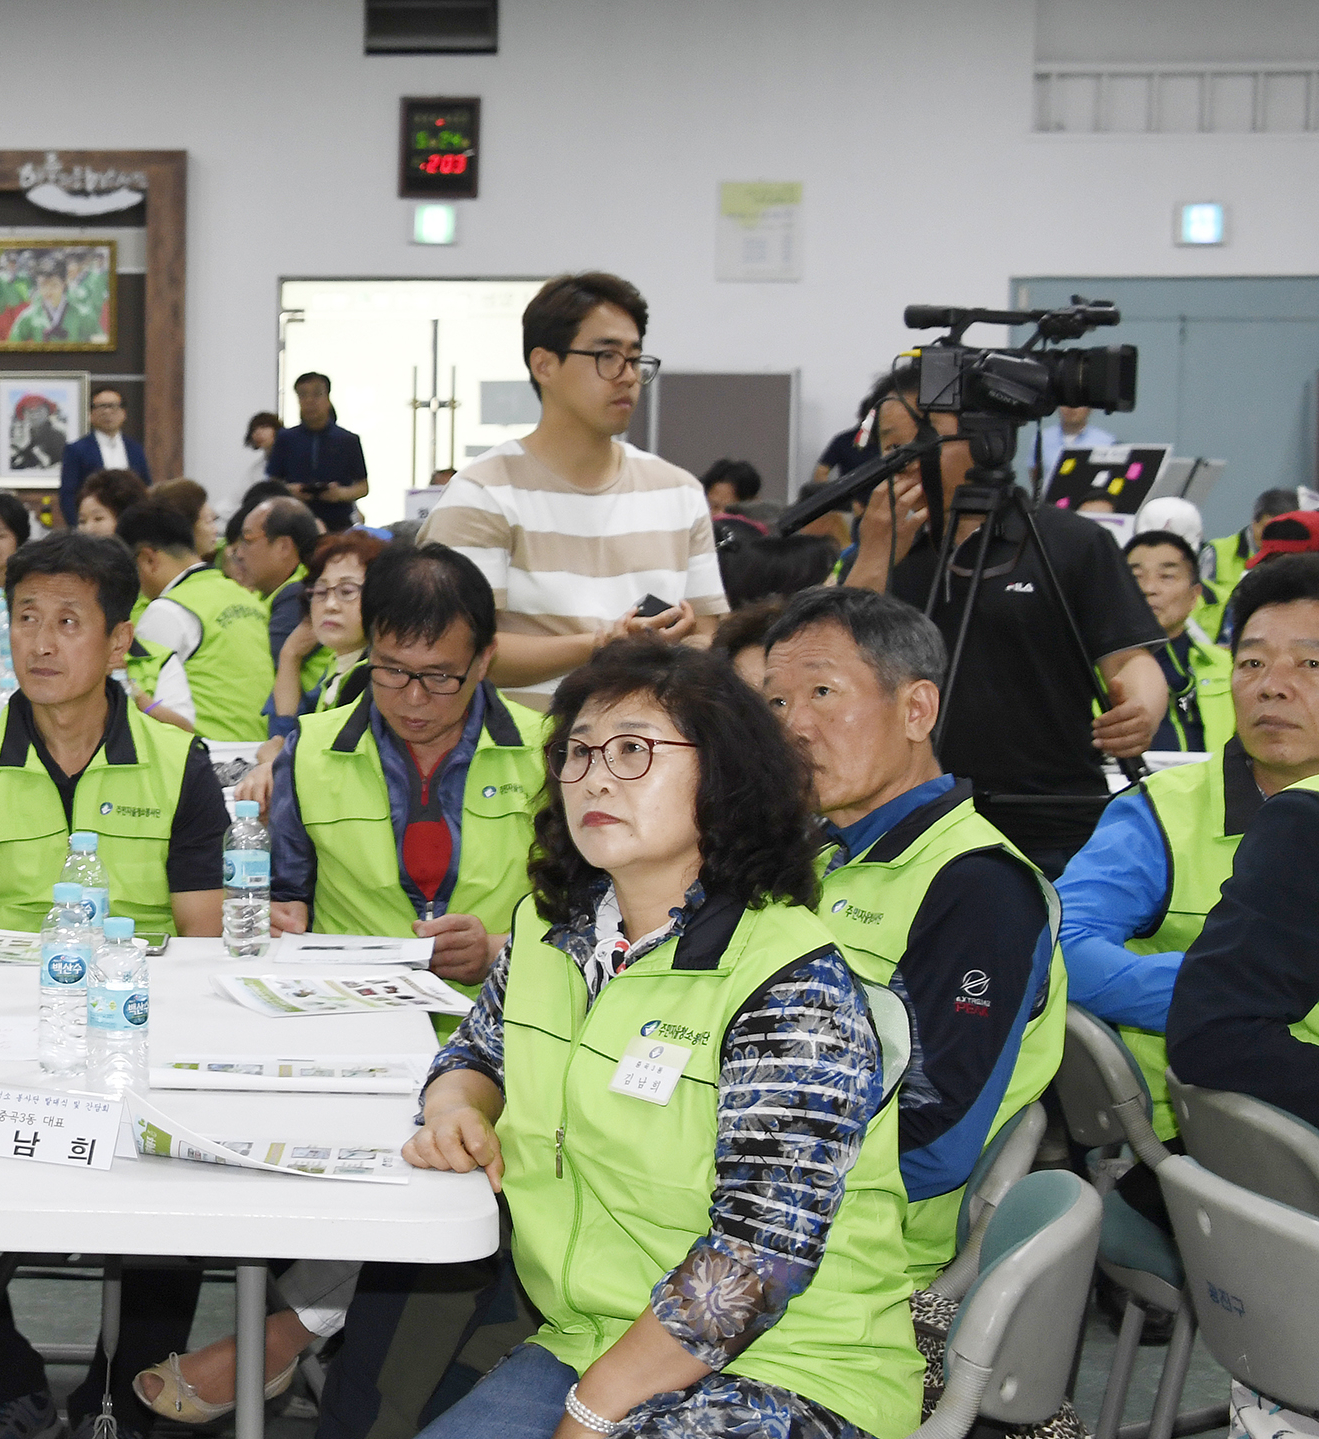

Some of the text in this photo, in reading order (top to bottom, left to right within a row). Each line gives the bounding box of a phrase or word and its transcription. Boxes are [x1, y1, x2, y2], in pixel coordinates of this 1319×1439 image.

[988, 389, 1020, 406] SONY
[1005, 582, 1034, 593] FILA
[52, 961, 83, 975] 백산수
[954, 1001, 990, 1017] PEAK
[15, 1093, 40, 1105] 봉사단
[44, 1096, 68, 1108] 발대식
[73, 1100, 81, 1109] 및
[85, 1102, 110, 1113] 간담회
[43, 1115, 65, 1128] 대표
